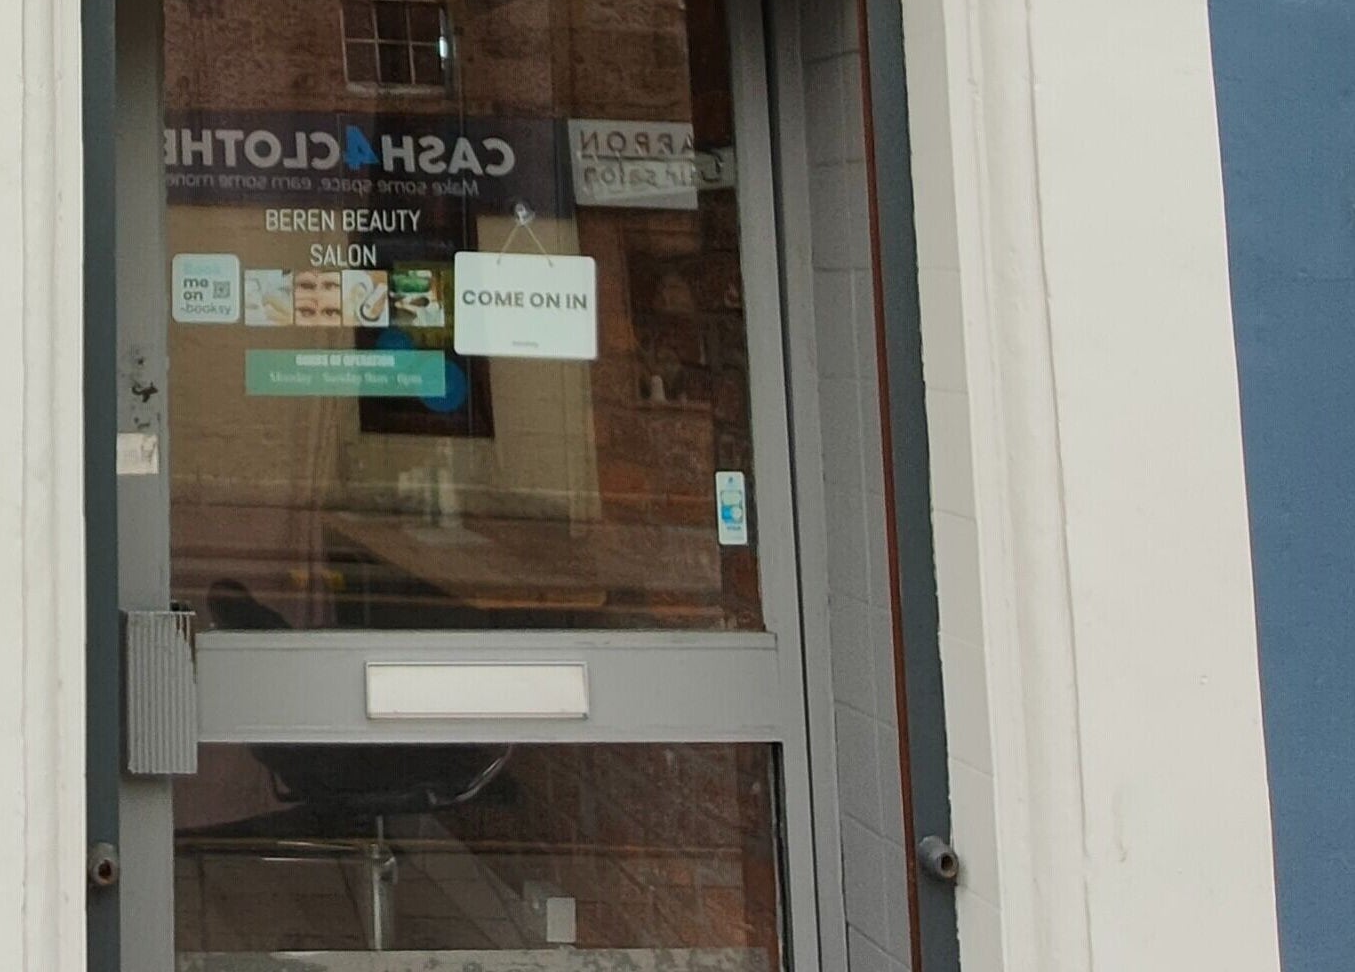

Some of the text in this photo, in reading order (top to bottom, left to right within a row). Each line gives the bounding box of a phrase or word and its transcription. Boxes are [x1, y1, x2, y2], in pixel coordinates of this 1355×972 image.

[265, 209, 420, 232] BEREN BEAUTY
[310, 243, 377, 267] SALON
[183, 291, 203, 300] on
[462, 290, 587, 310] COME ON IN
